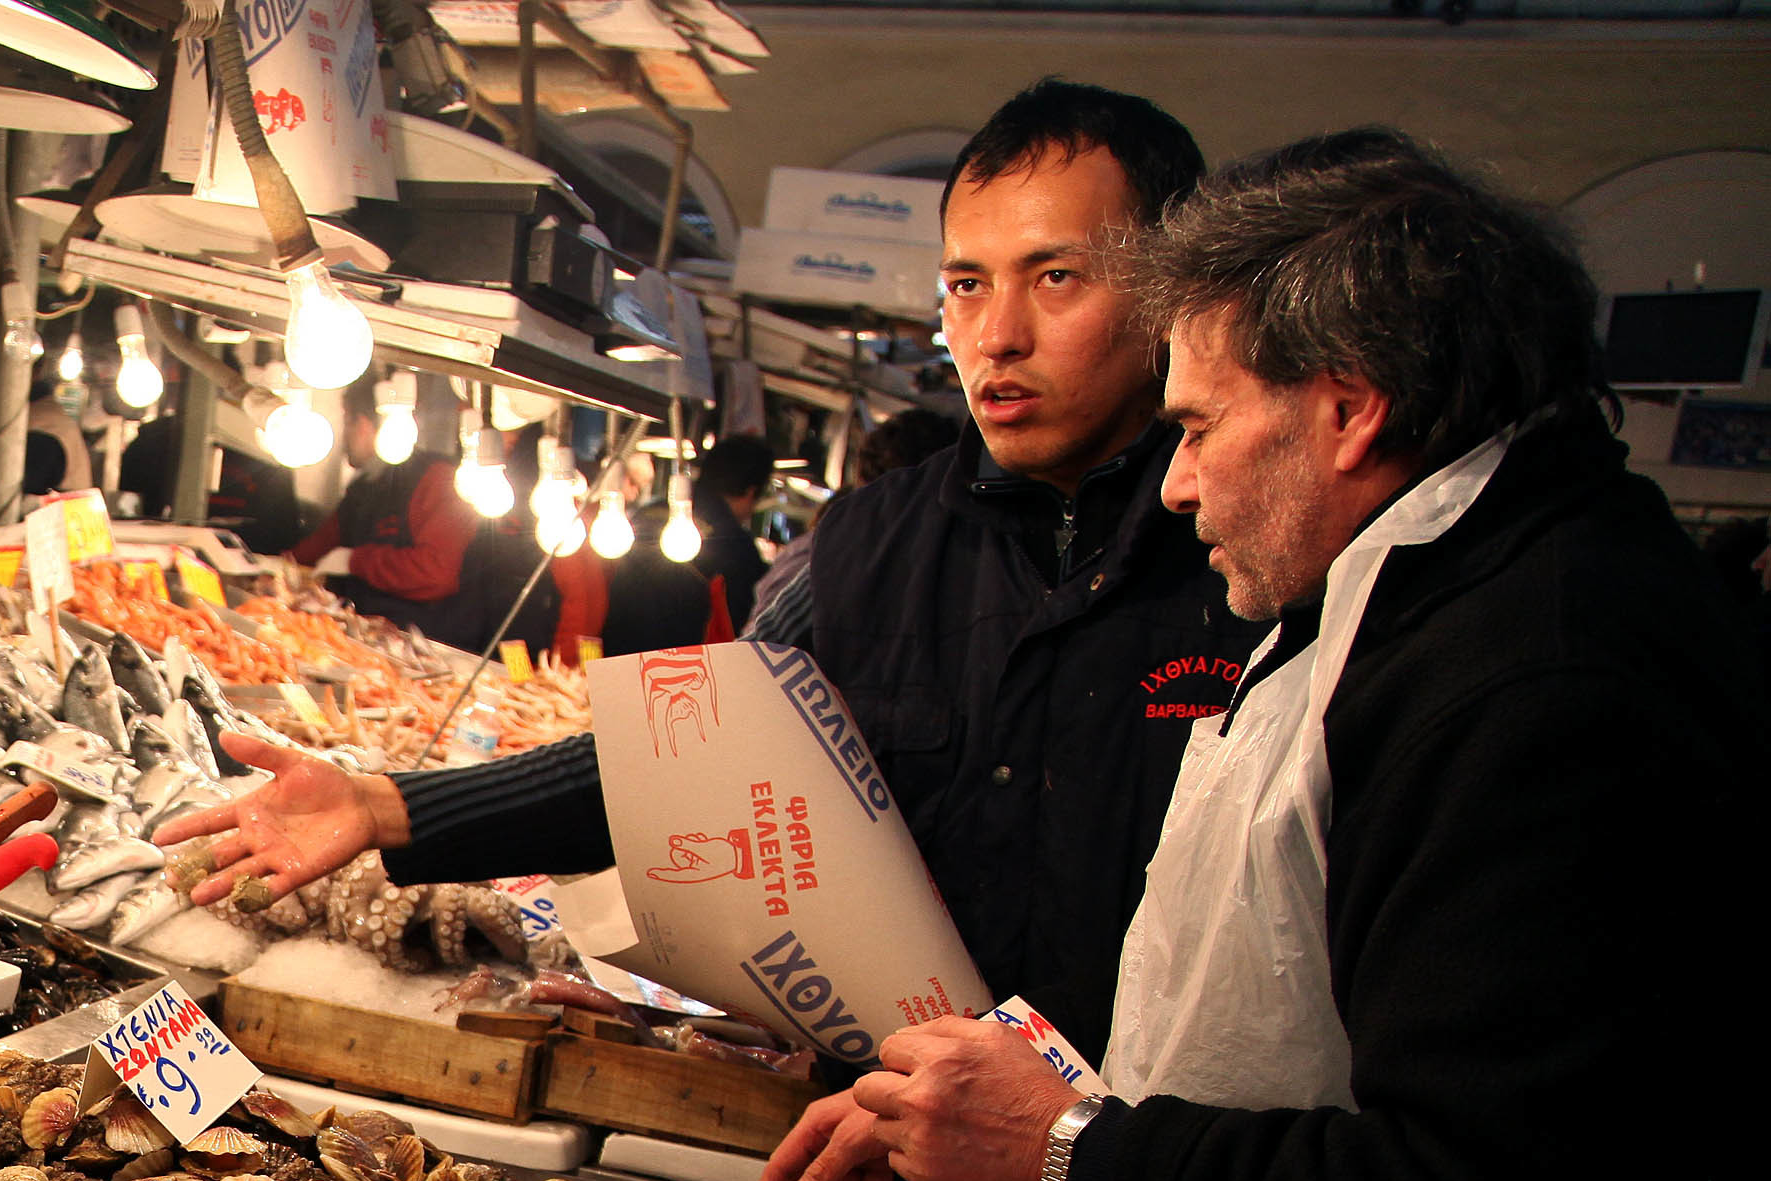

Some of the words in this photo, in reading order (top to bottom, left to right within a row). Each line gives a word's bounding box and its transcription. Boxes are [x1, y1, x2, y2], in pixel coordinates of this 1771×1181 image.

[1139, 656, 1244, 694] ΙΧΘΥΑΓΟ
[1145, 703, 1230, 718] ΒΑΡΒΑΚΕ
[749, 780, 791, 917] ΕΚΛΕΚΤΑ
[785, 796, 818, 891] ΨΑΡΙΑ
[98, 989, 182, 1062] ΧΤΕΝΙΑ
[114, 999, 206, 1082] ΖΩΝΤΑΝΑ
